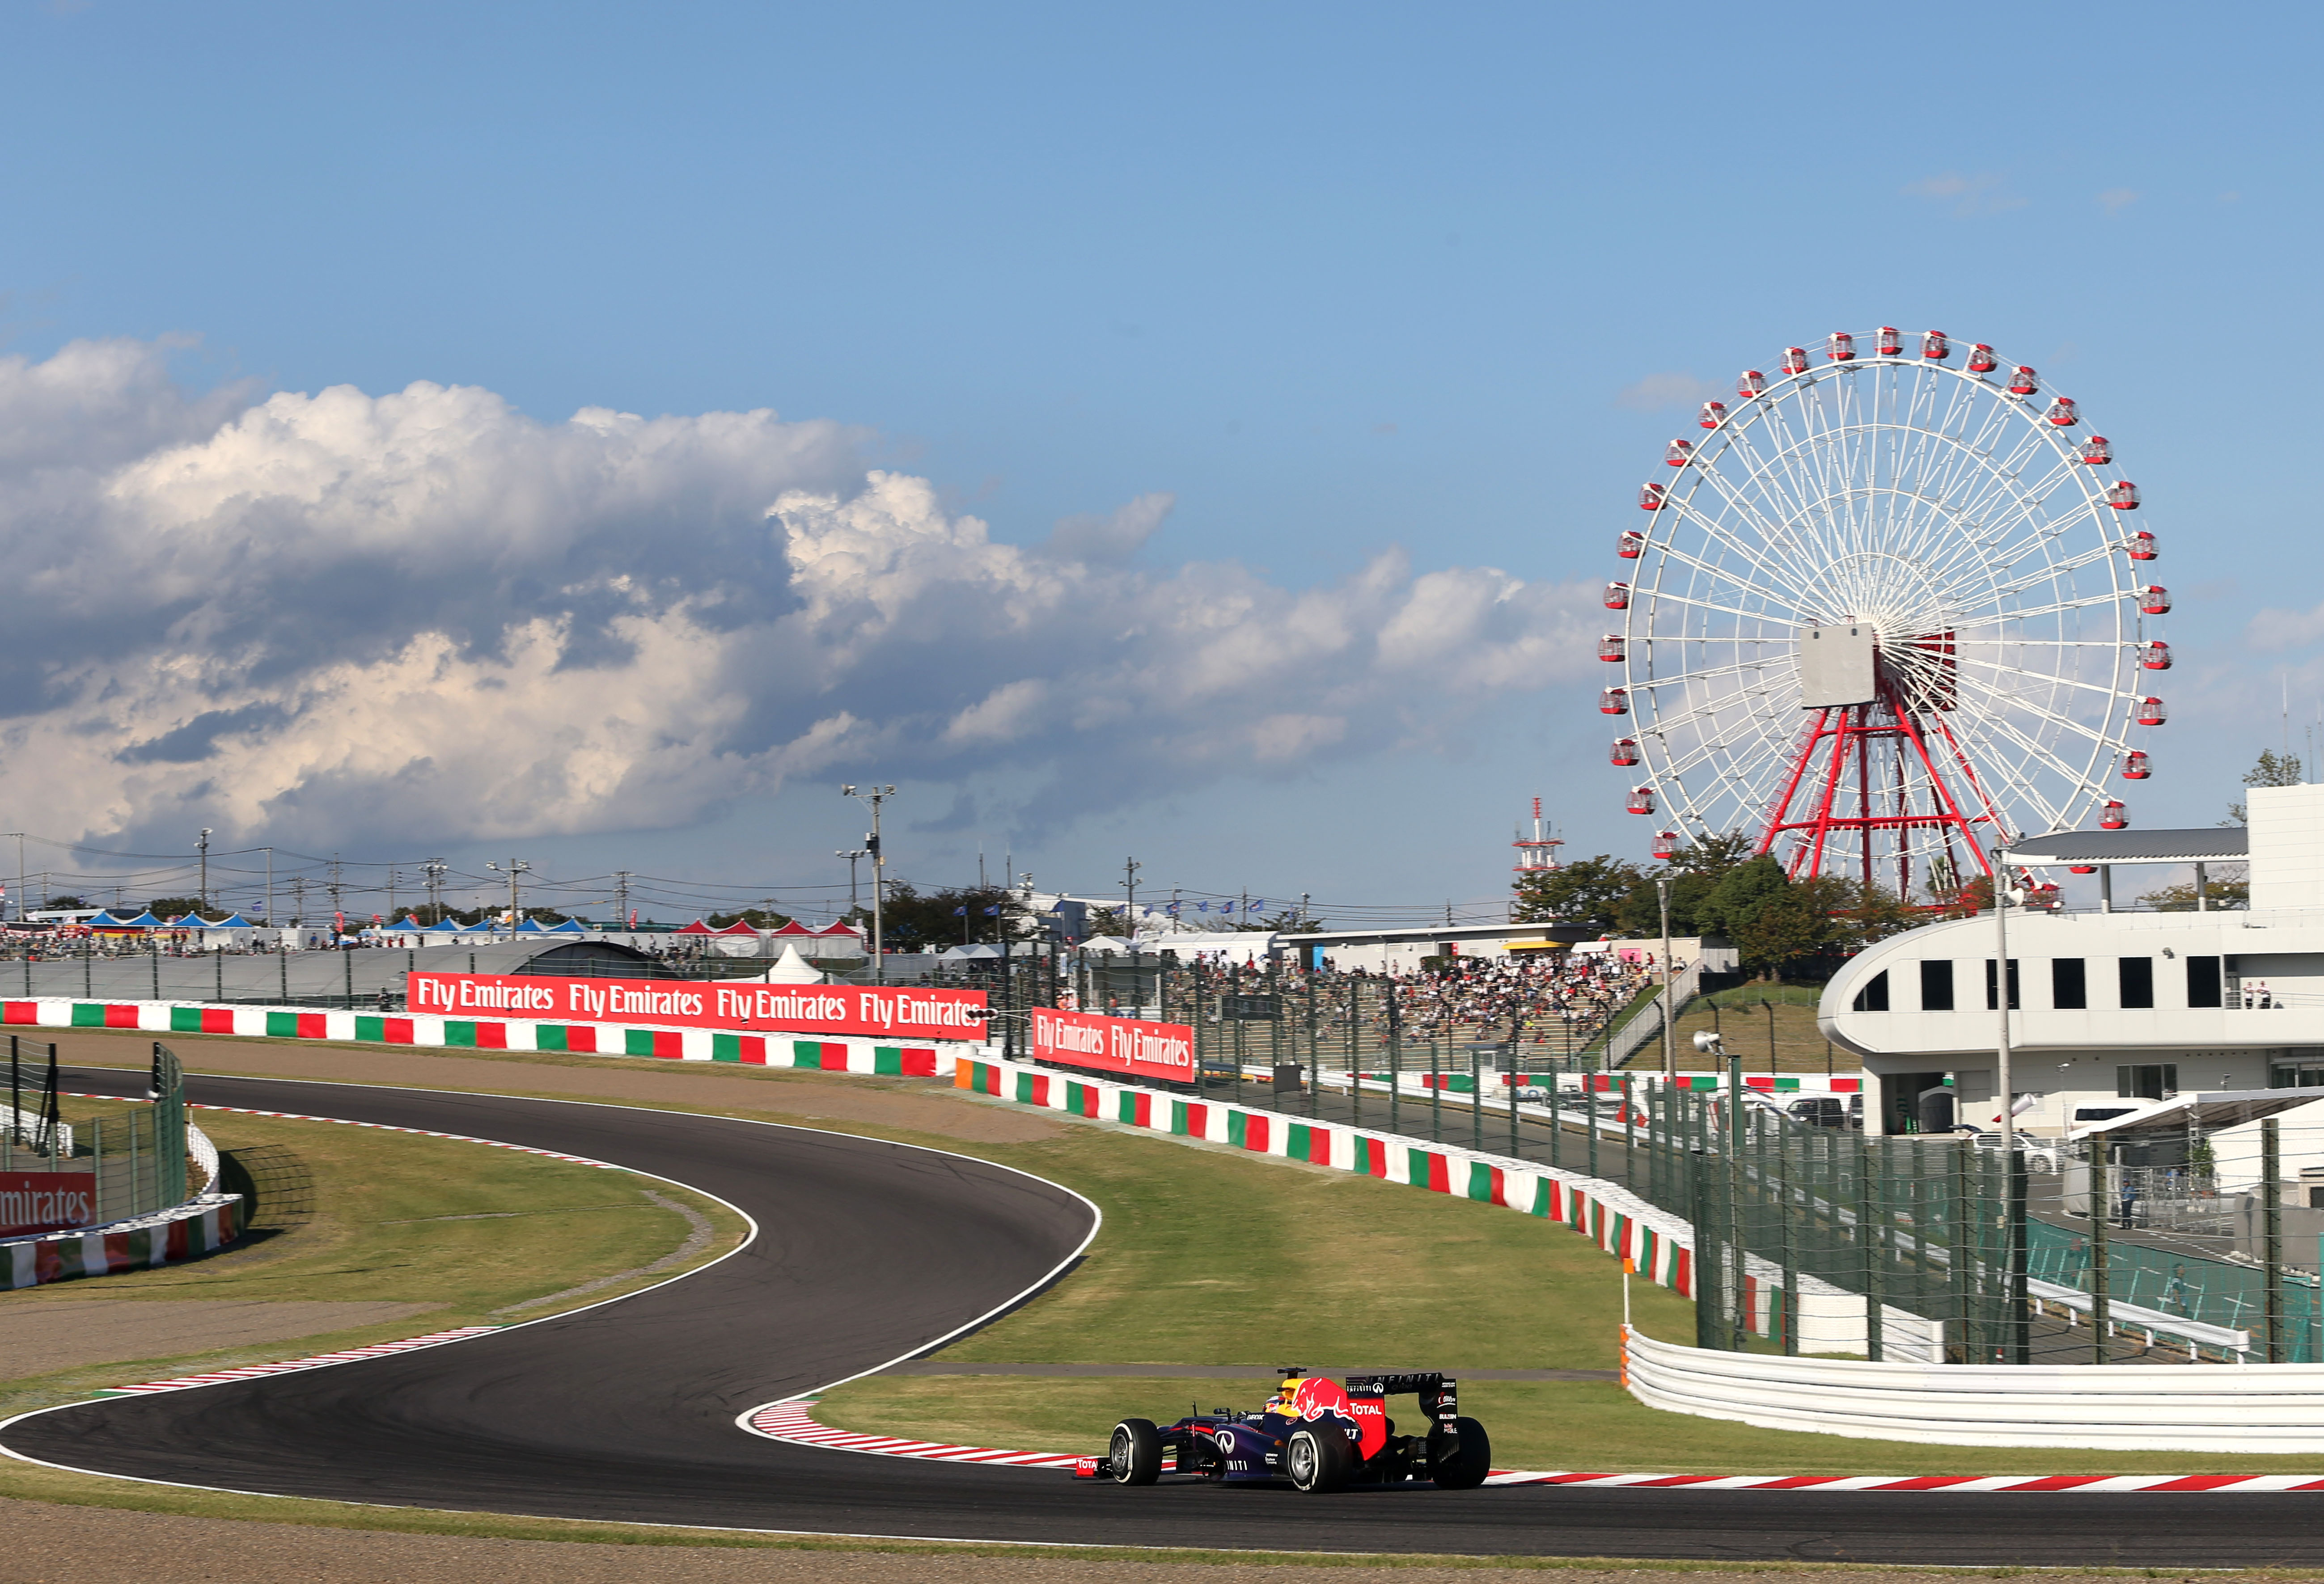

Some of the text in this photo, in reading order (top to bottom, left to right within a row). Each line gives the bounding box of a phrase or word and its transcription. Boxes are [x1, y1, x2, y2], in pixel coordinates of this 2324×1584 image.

[418, 978, 554, 1012] Fly Emirates
[569, 984, 703, 1018] Fly Emirates
[716, 989, 846, 1024] Fly Emirates
[859, 993, 893, 1029] Fly
[1037, 1015, 1104, 1055] Fly Emirates
[1111, 1025, 1190, 1067] Fly Emirates
[1369, 1373, 1439, 1384] INFINITI
[1350, 1403, 1382, 1415] TOTAL
[1344, 1428, 1359, 1440] LT
[1077, 1459, 1098, 1470] TOTA
